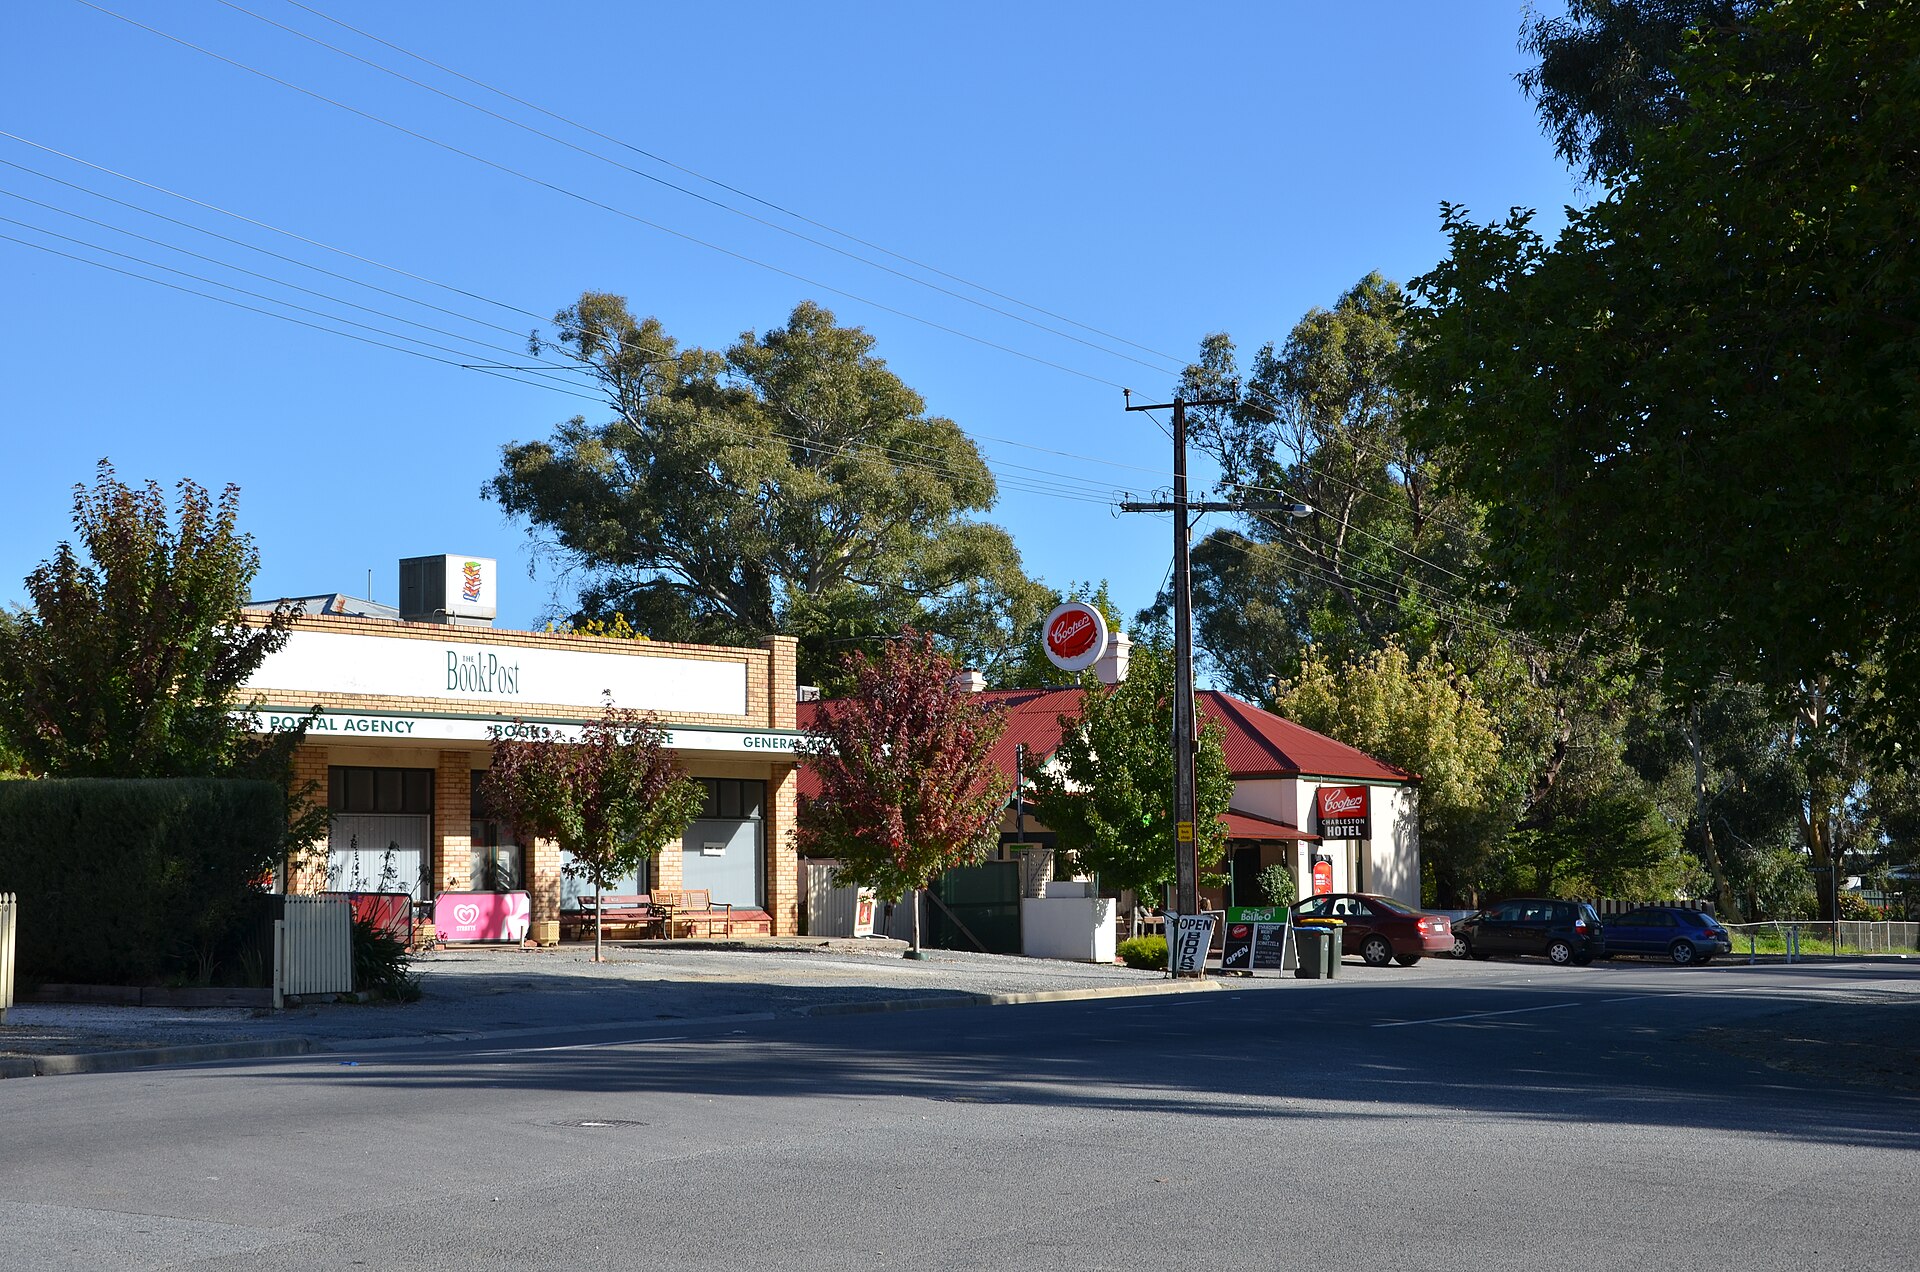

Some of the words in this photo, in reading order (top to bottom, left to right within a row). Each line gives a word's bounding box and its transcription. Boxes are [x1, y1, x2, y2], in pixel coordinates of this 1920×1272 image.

[446, 651, 519, 694] BookPost
[344, 718, 415, 733] AGENCY
[623, 730, 674, 744] CEE
[743, 736, 801, 750] GENERA
[1324, 788, 1363, 813] Coopers
[1326, 825, 1362, 836] HOTEL
[1180, 918, 1212, 930] OPEN
[1179, 931, 1200, 970] BOOKS
[1226, 945, 1249, 965] OPEN
